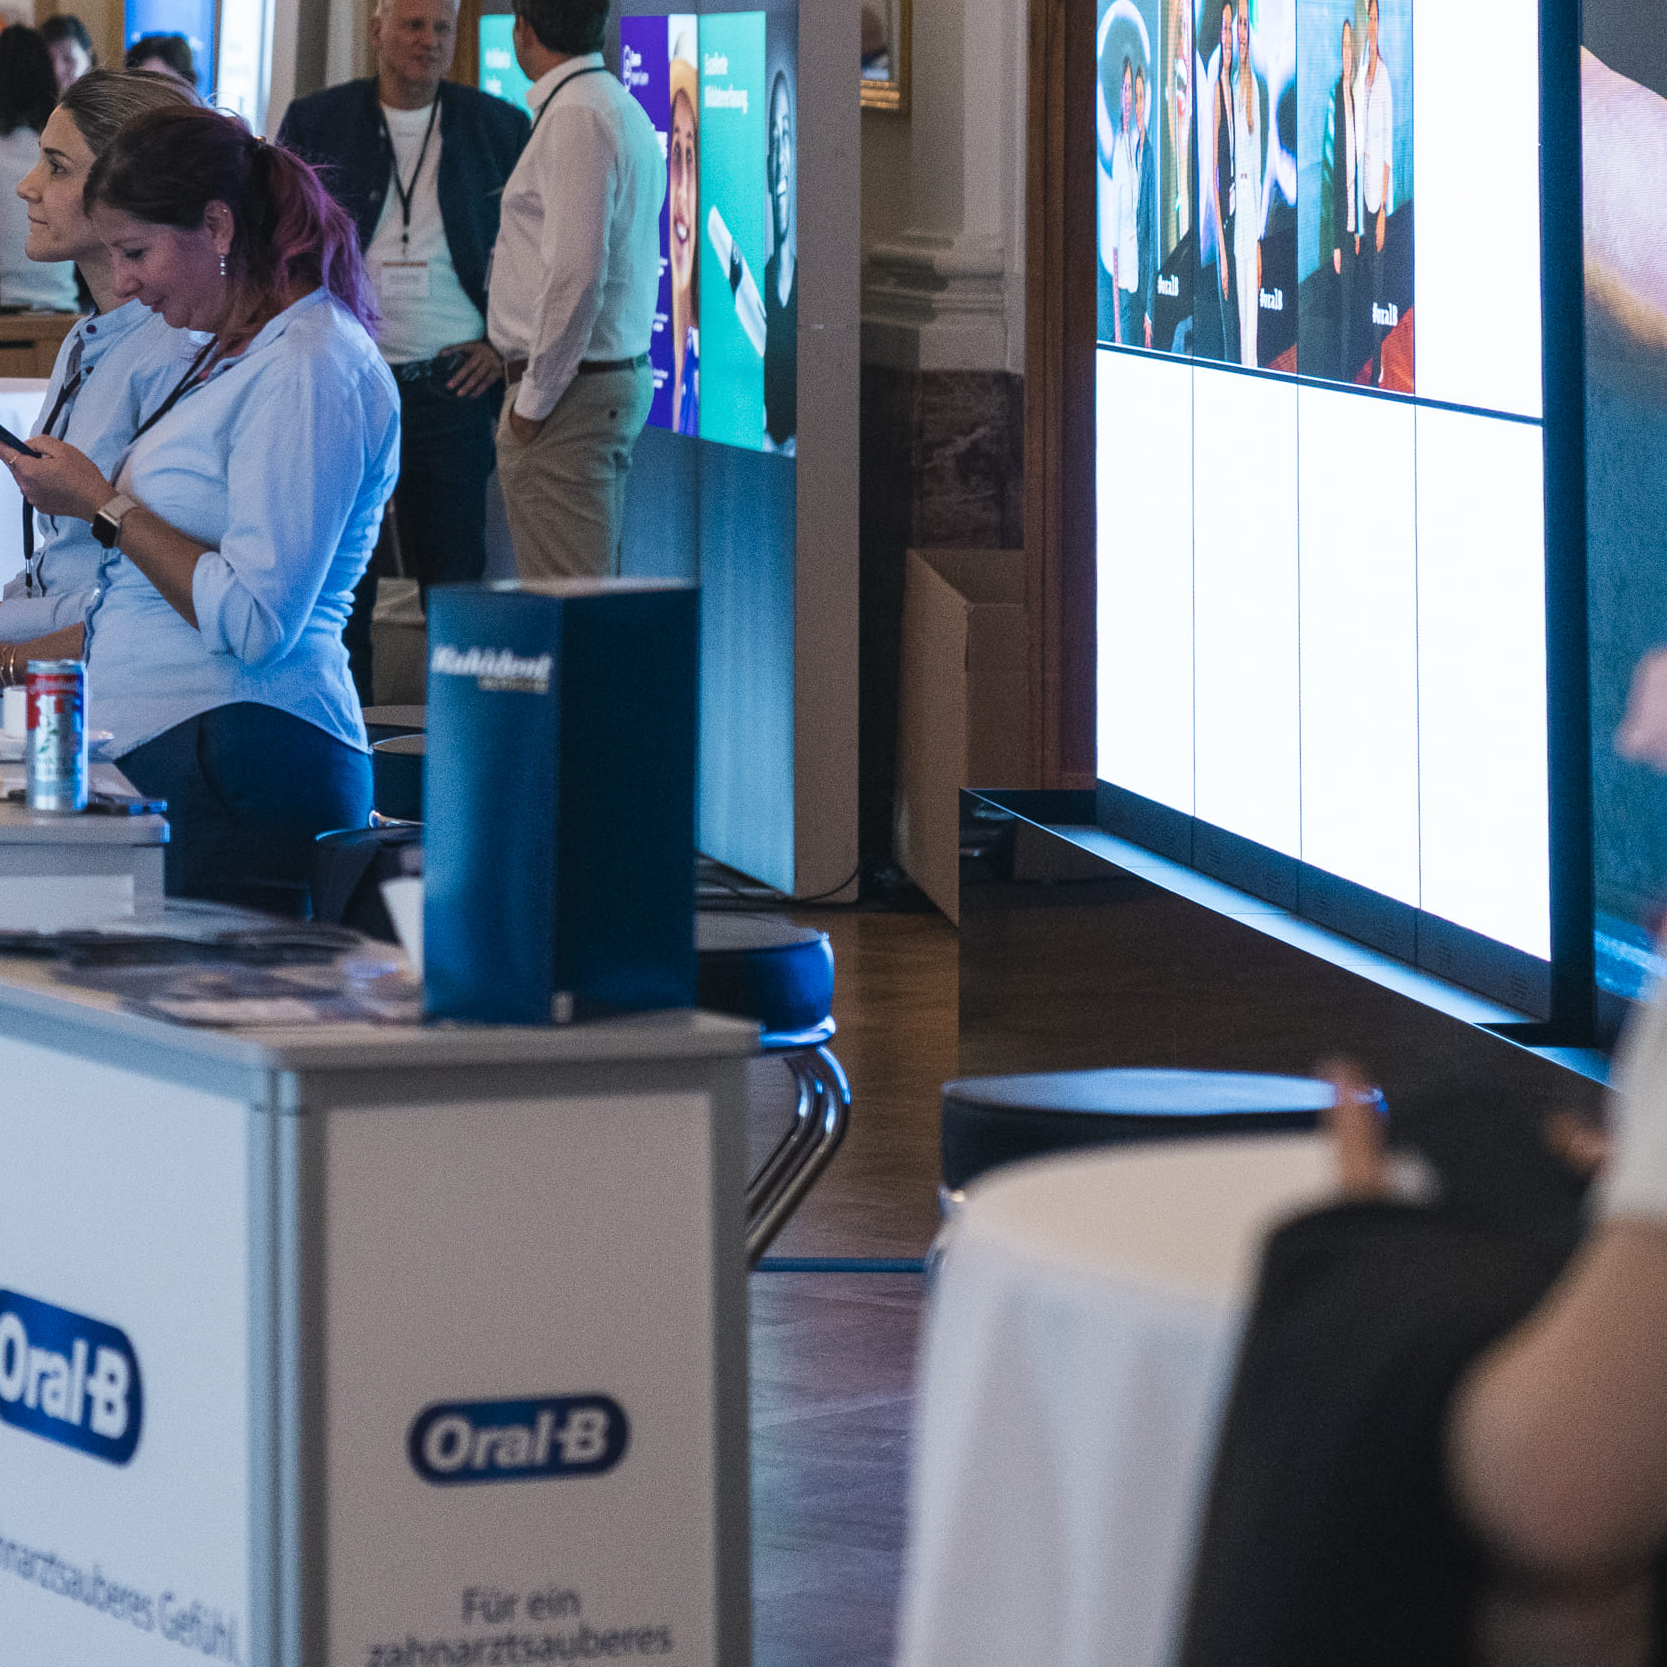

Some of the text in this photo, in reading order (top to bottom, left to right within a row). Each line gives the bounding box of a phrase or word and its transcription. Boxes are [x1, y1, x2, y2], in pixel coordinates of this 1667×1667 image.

[431, 645, 554, 679] Kukident
[422, 1407, 611, 1473] Oral-B
[460, 1586, 581, 1625] Für ein
[366, 1621, 672, 1667] zahnarztsauberes
